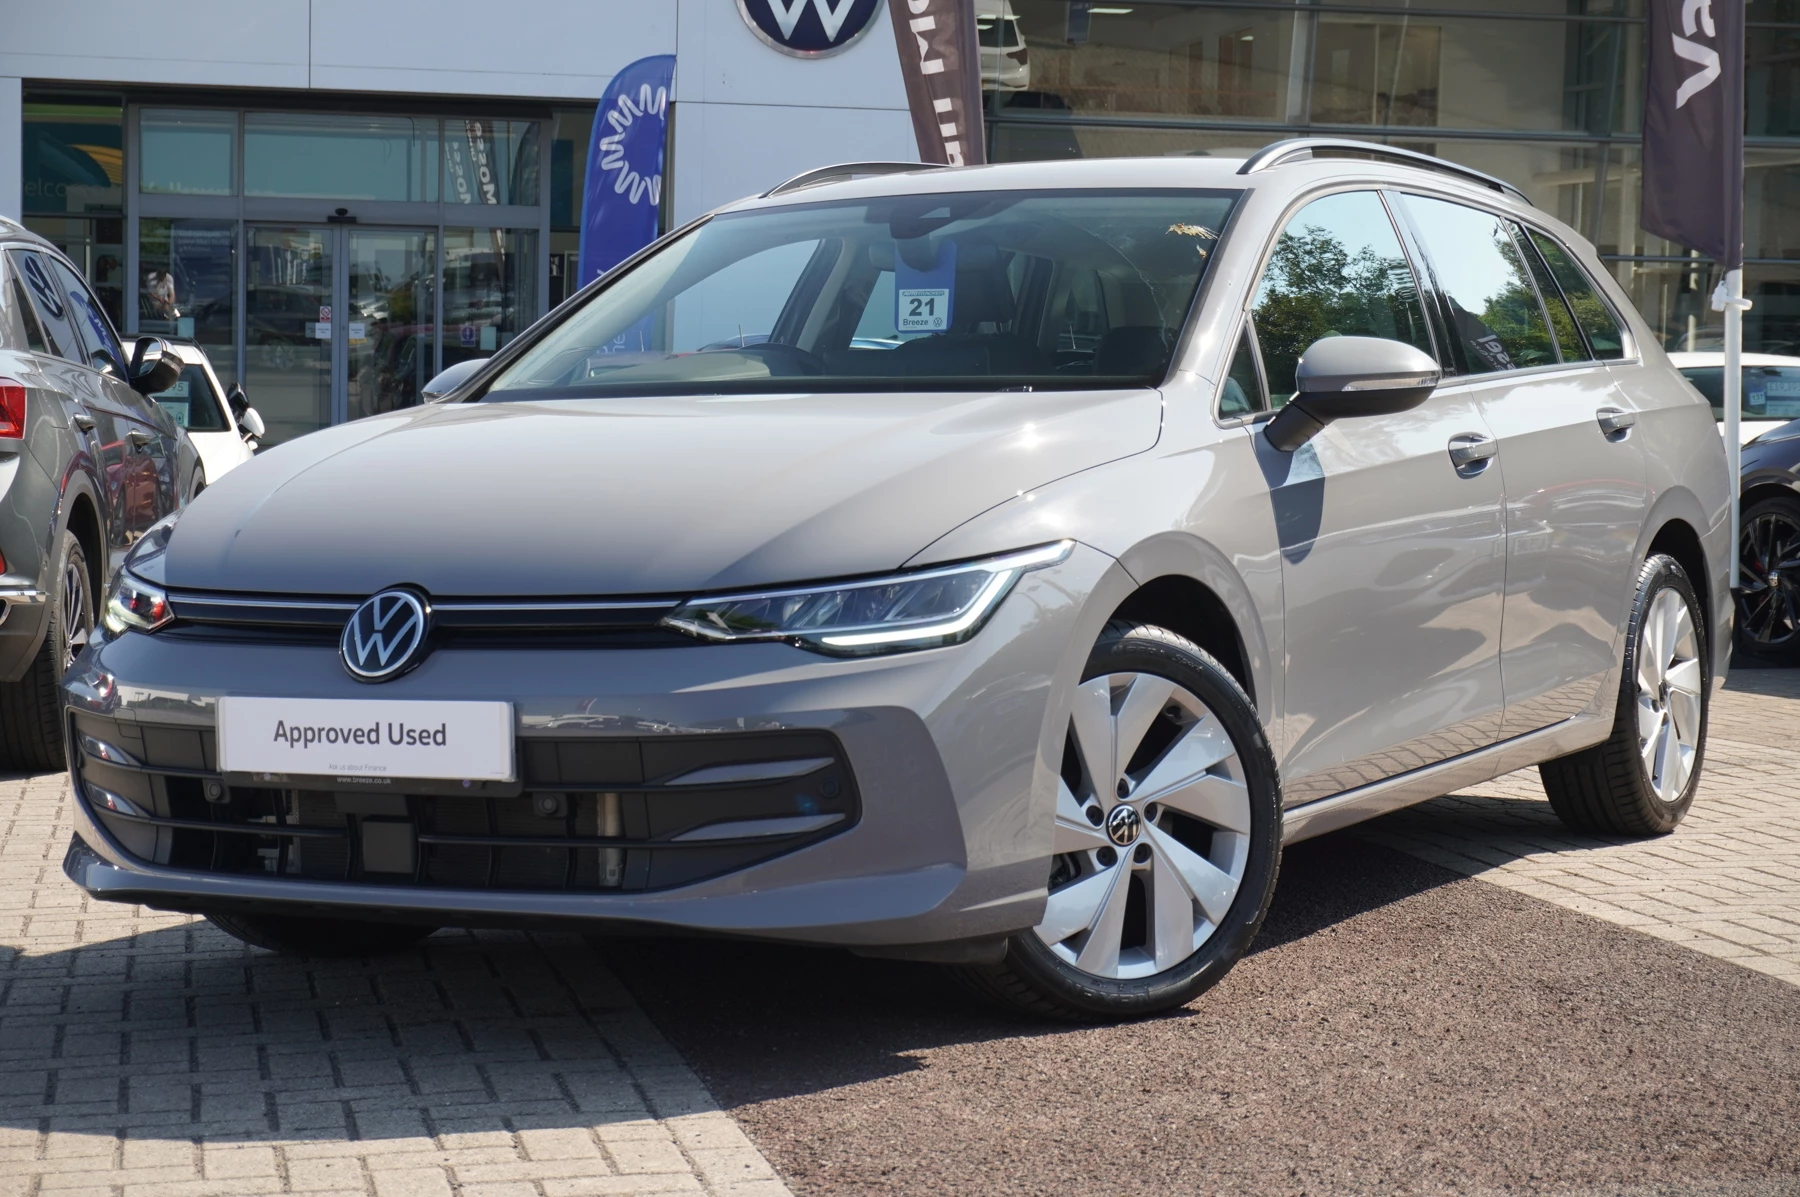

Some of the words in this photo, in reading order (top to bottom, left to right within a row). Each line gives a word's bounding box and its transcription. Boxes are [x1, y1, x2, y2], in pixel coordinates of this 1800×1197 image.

[908, 298, 935, 316] 21
[903, 318, 929, 326] Breeze
[273, 719, 380, 749] Approved
[387, 722, 447, 747] Used
[328, 763, 338, 771] Ask
[346, 763, 363, 772] about
[364, 763, 387, 772] Finance
[336, 776, 392, 785] www.breeze.co.uk
